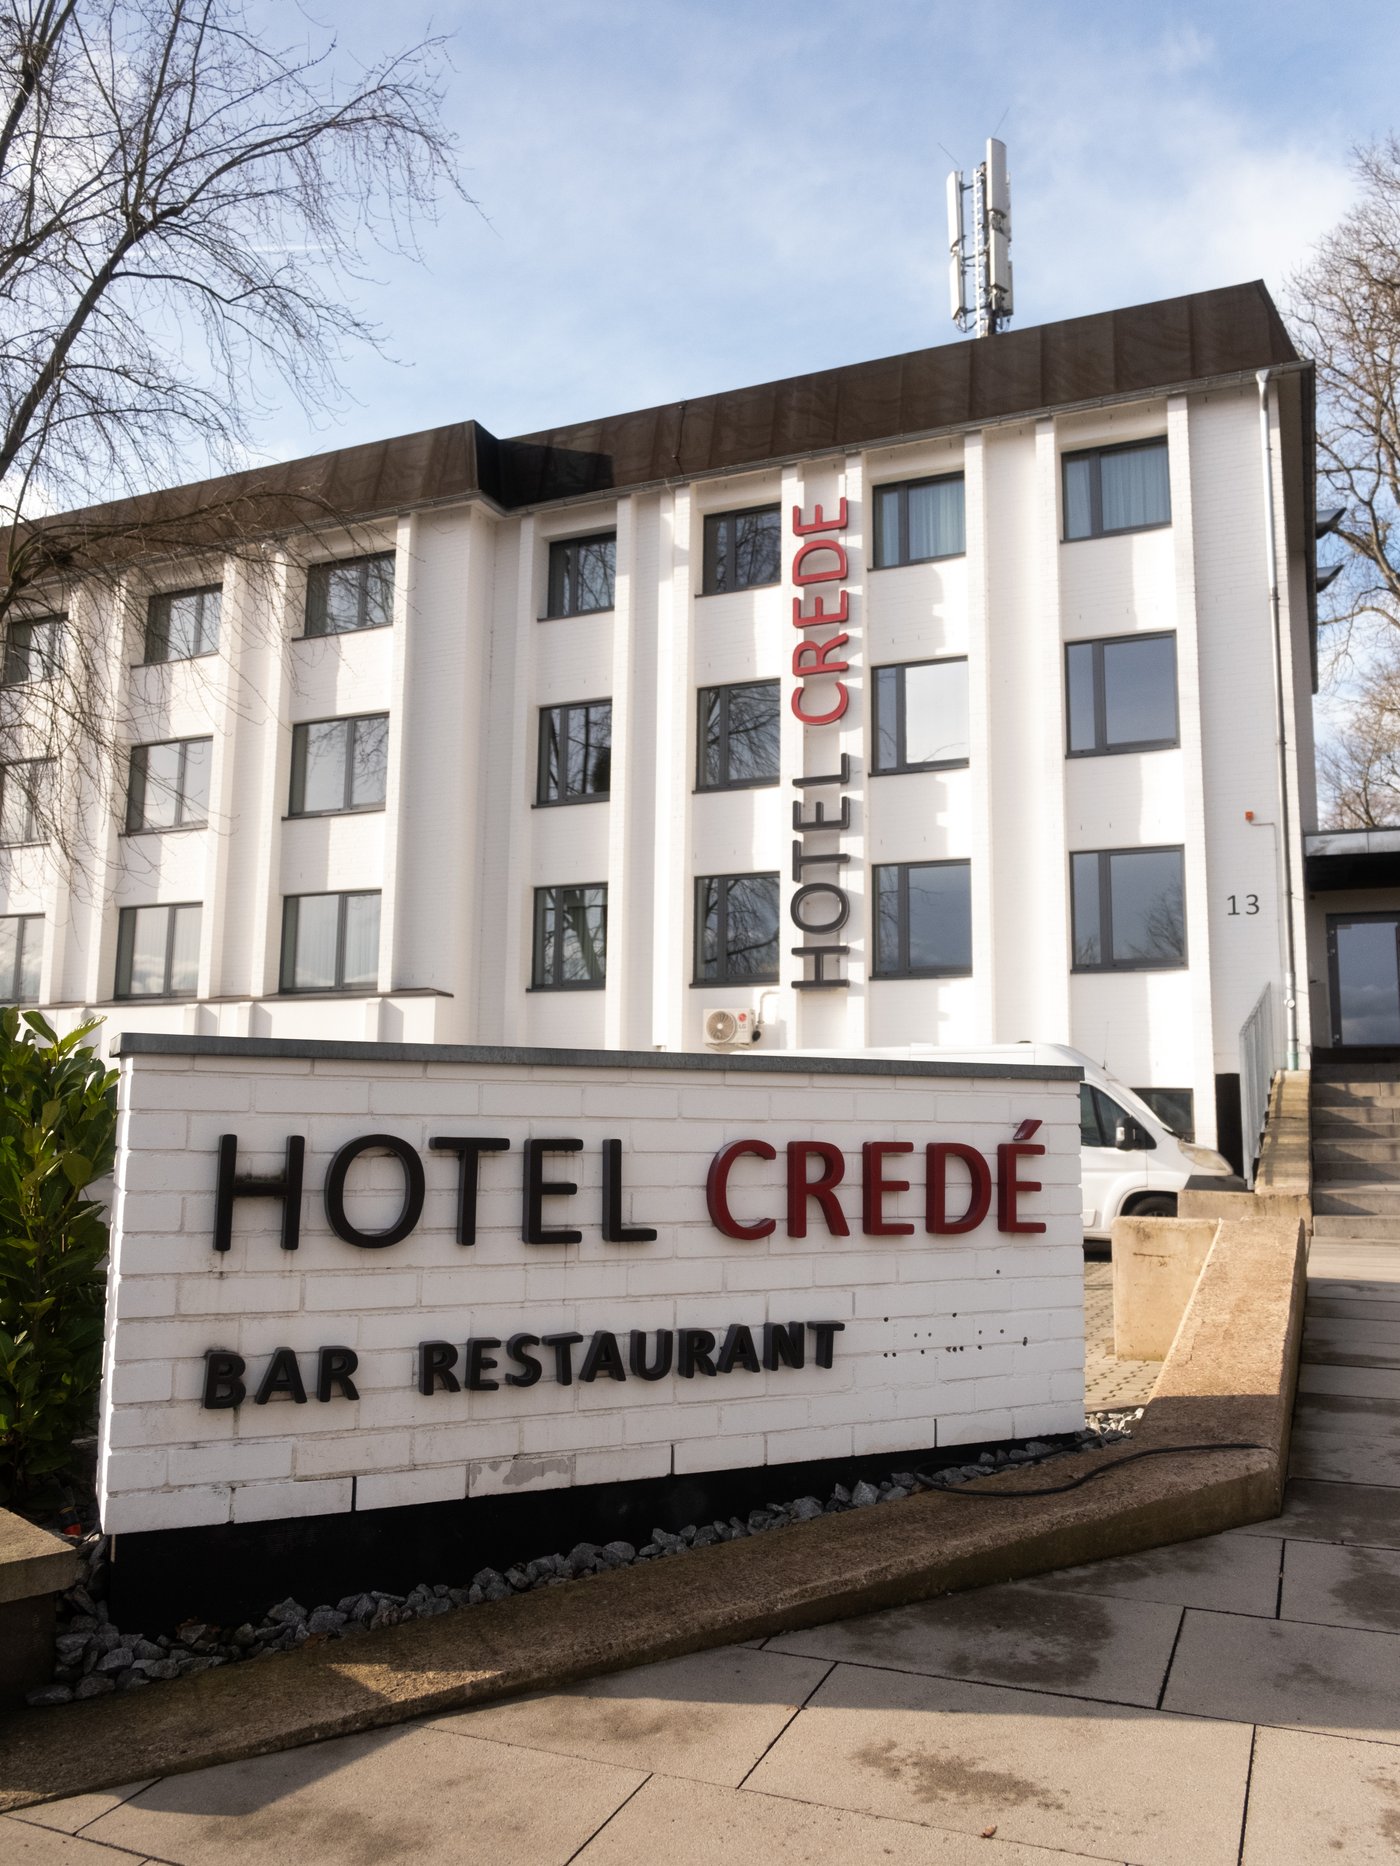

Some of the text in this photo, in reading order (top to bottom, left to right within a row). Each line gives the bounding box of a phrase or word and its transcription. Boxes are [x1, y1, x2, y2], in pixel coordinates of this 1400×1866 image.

[790, 496, 850, 989] HOTEL CREDE
[1227, 894, 1260, 916] 13
[212, 1118, 1047, 1252] HOTEL CREDÉ
[202, 1320, 845, 1410] BAR RESTAURANT
